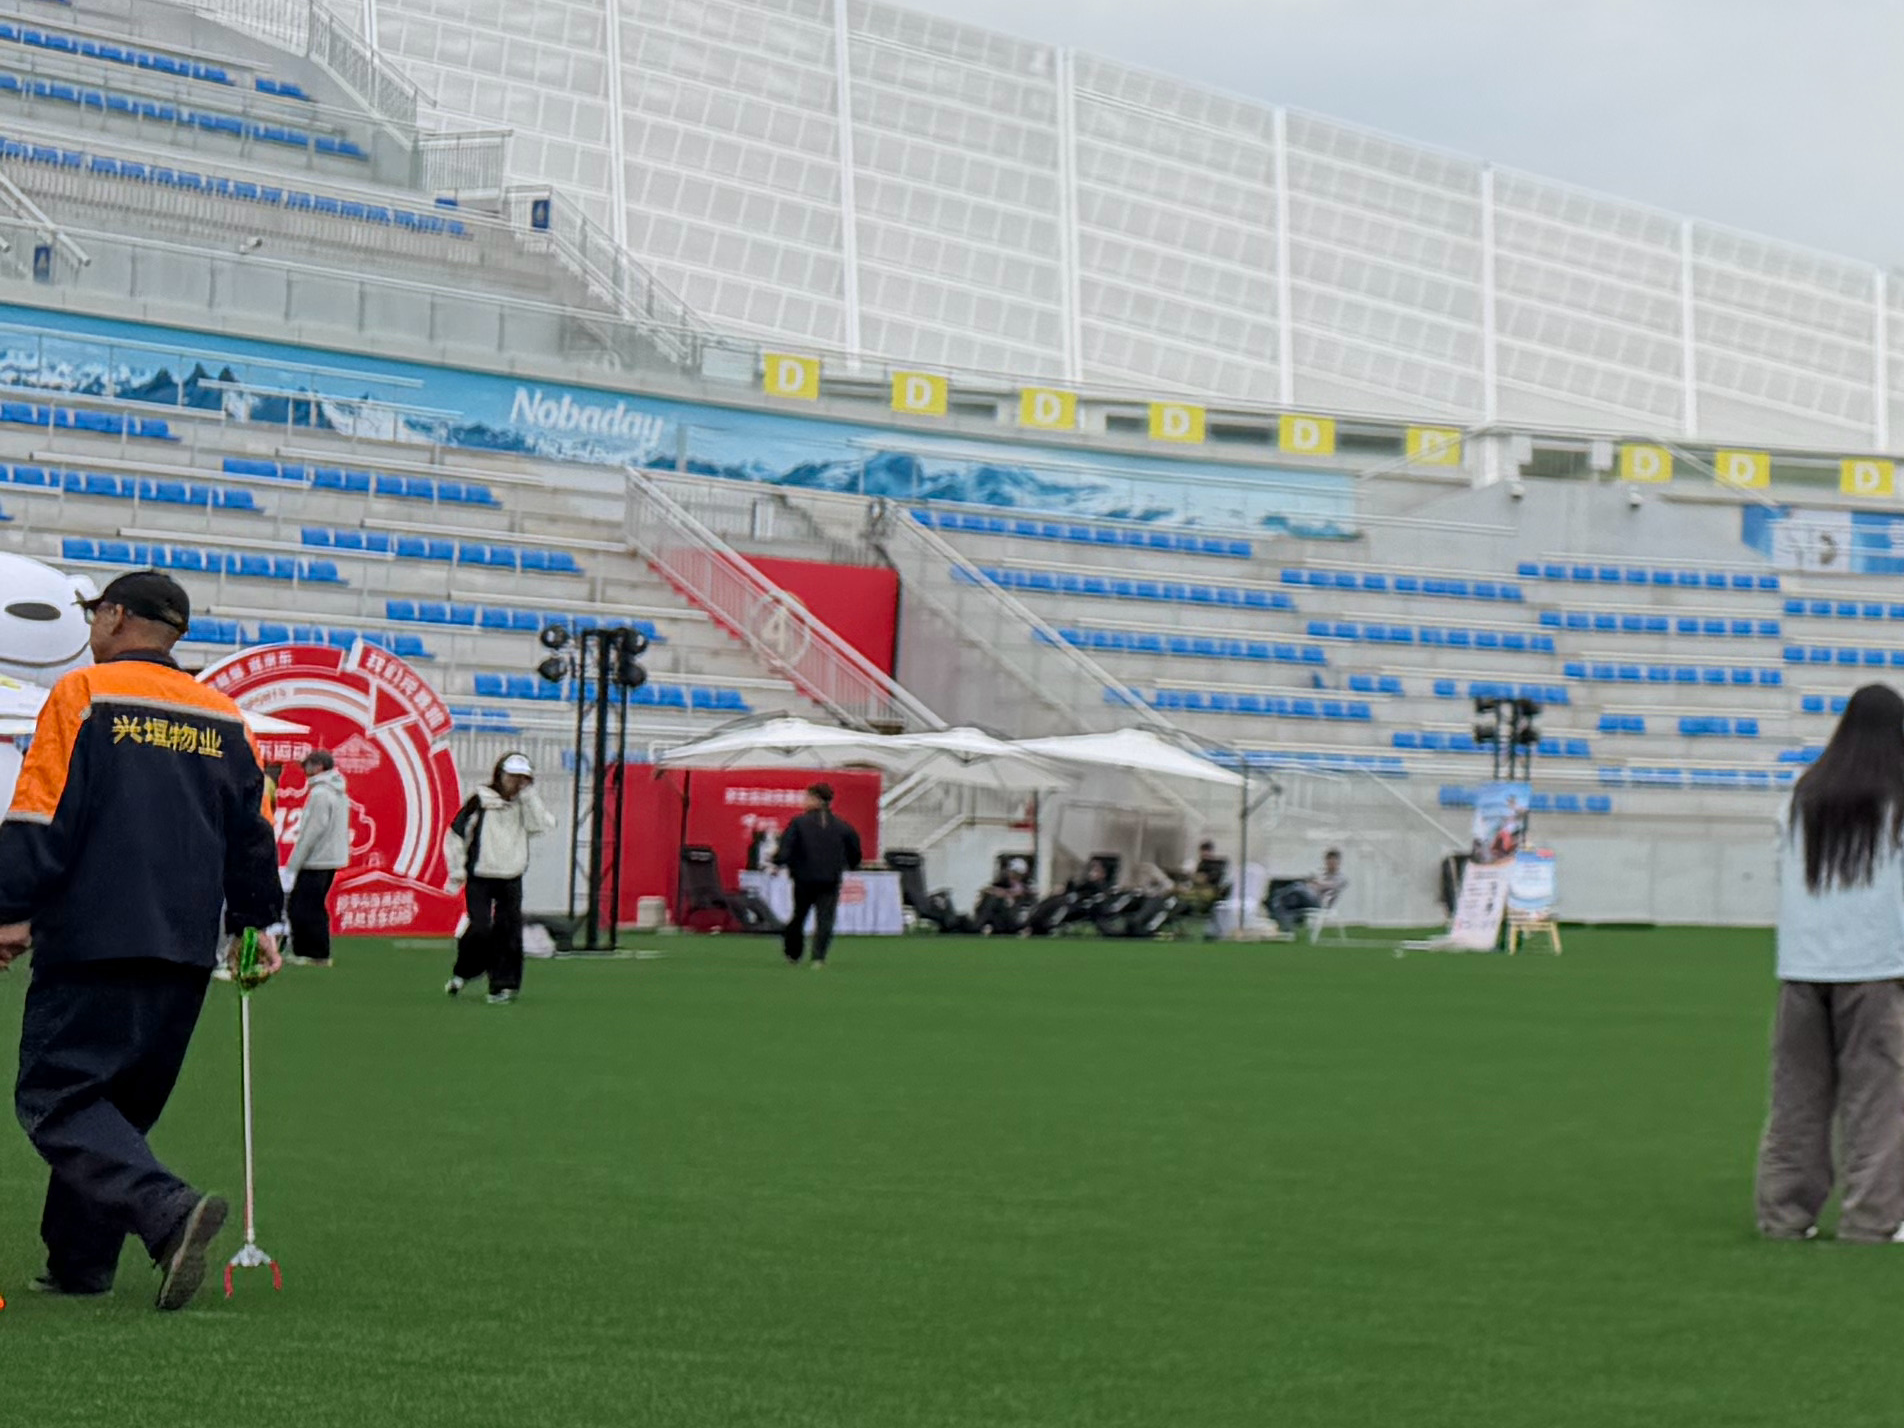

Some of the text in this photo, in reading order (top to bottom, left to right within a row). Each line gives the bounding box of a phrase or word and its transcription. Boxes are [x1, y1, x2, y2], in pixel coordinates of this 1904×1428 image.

[777, 360, 804, 391] D
[906, 377, 931, 408] D
[1035, 393, 1061, 422] D
[1163, 407, 1189, 436] D
[1293, 420, 1319, 449] D
[1420, 431, 1447, 460] D
[1633, 447, 1660, 477] D
[1730, 456, 1756, 484] D
[1855, 463, 1879, 491] D
